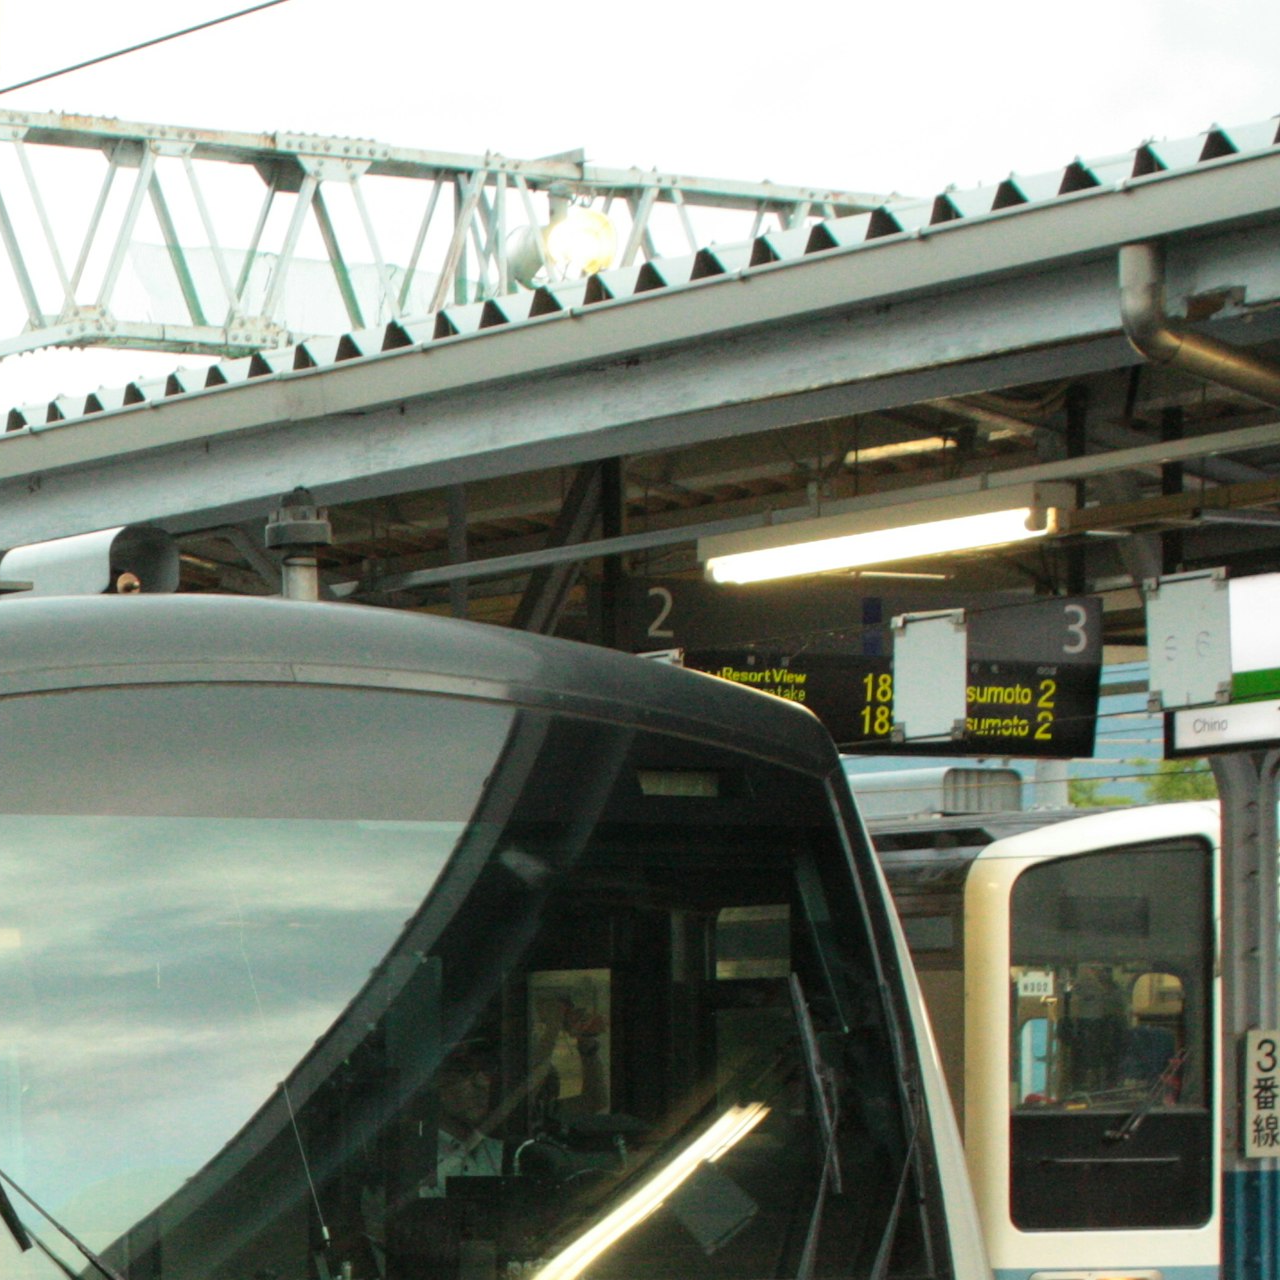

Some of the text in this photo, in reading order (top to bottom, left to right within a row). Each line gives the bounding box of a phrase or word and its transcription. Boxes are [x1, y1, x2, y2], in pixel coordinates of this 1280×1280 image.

[647, 586, 674, 638] 2
[1062, 604, 1088, 654] 3
[722, 667, 771, 684] Resort
[772, 668, 807, 684] View
[863, 672, 896, 702] 18
[965, 679, 1057, 708] sumoto 2
[860, 705, 894, 735] 18
[965, 711, 1054, 739] sumoto 2
[1192, 718, 1228, 734] Chino
